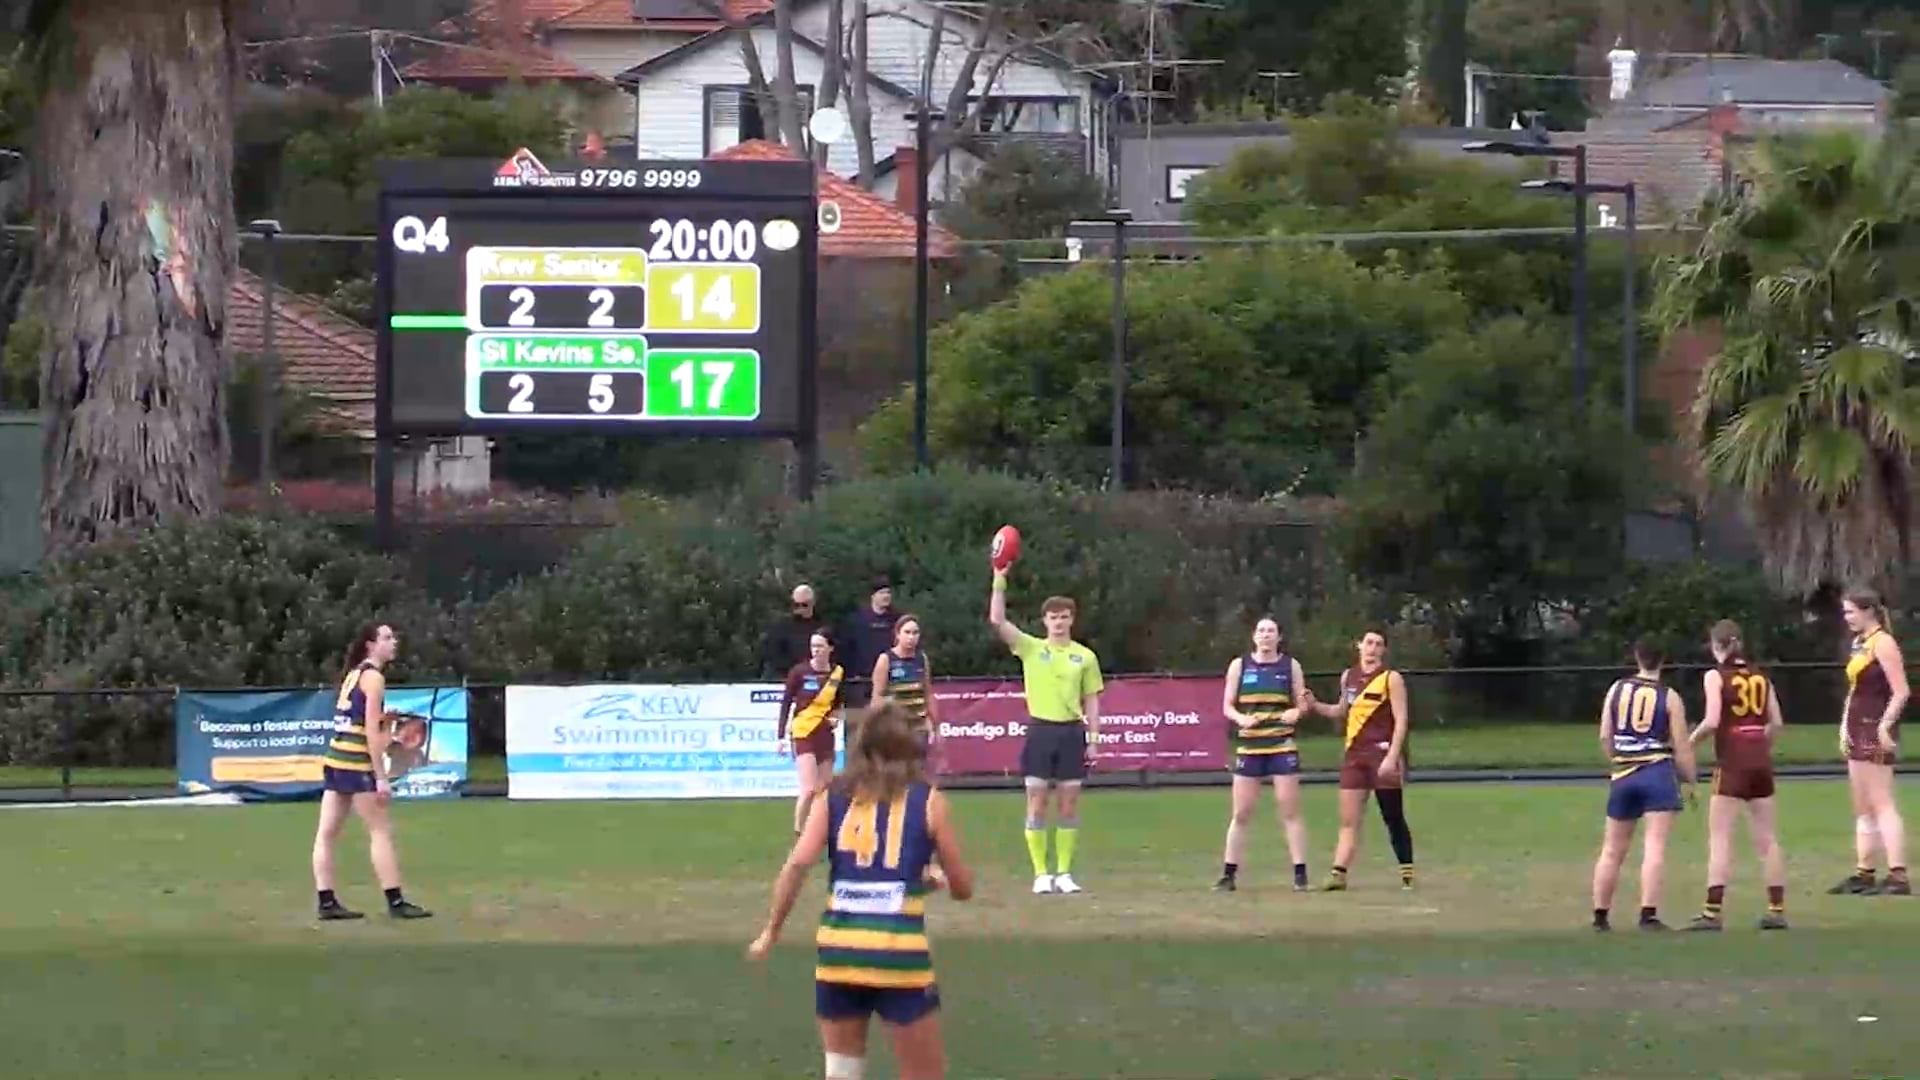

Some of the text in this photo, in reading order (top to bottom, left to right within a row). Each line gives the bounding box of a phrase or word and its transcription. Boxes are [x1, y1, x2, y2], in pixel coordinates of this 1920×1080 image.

[580, 169, 637, 187] 9796
[643, 169, 702, 188] 9999
[392, 216, 450, 252] Q4
[649, 219, 756, 261] 20:00
[481, 251, 537, 277] Kew
[508, 287, 615, 327] 2 2
[671, 274, 737, 321] 14
[481, 340, 510, 364] St
[514, 340, 594, 364] Kevins
[507, 373, 615, 413] 2 5
[670, 361, 736, 409] 17
[641, 695, 702, 715] KEW
[752, 692, 785, 702] ASTR
[1617, 682, 1658, 733] 10
[1731, 674, 1767, 717] 30
[200, 720, 251, 733] Become
[264, 719, 300, 731] foster
[1165, 711, 1200, 725] Bank
[212, 736, 259, 749] Support
[269, 735, 296, 747] local
[297, 734, 326, 746] child
[553, 724, 708, 748] Swimming
[939, 722, 1028, 741] Bendigo Ba
[1085, 731, 1157, 744] Iner East
[837, 792, 909, 869] 41
